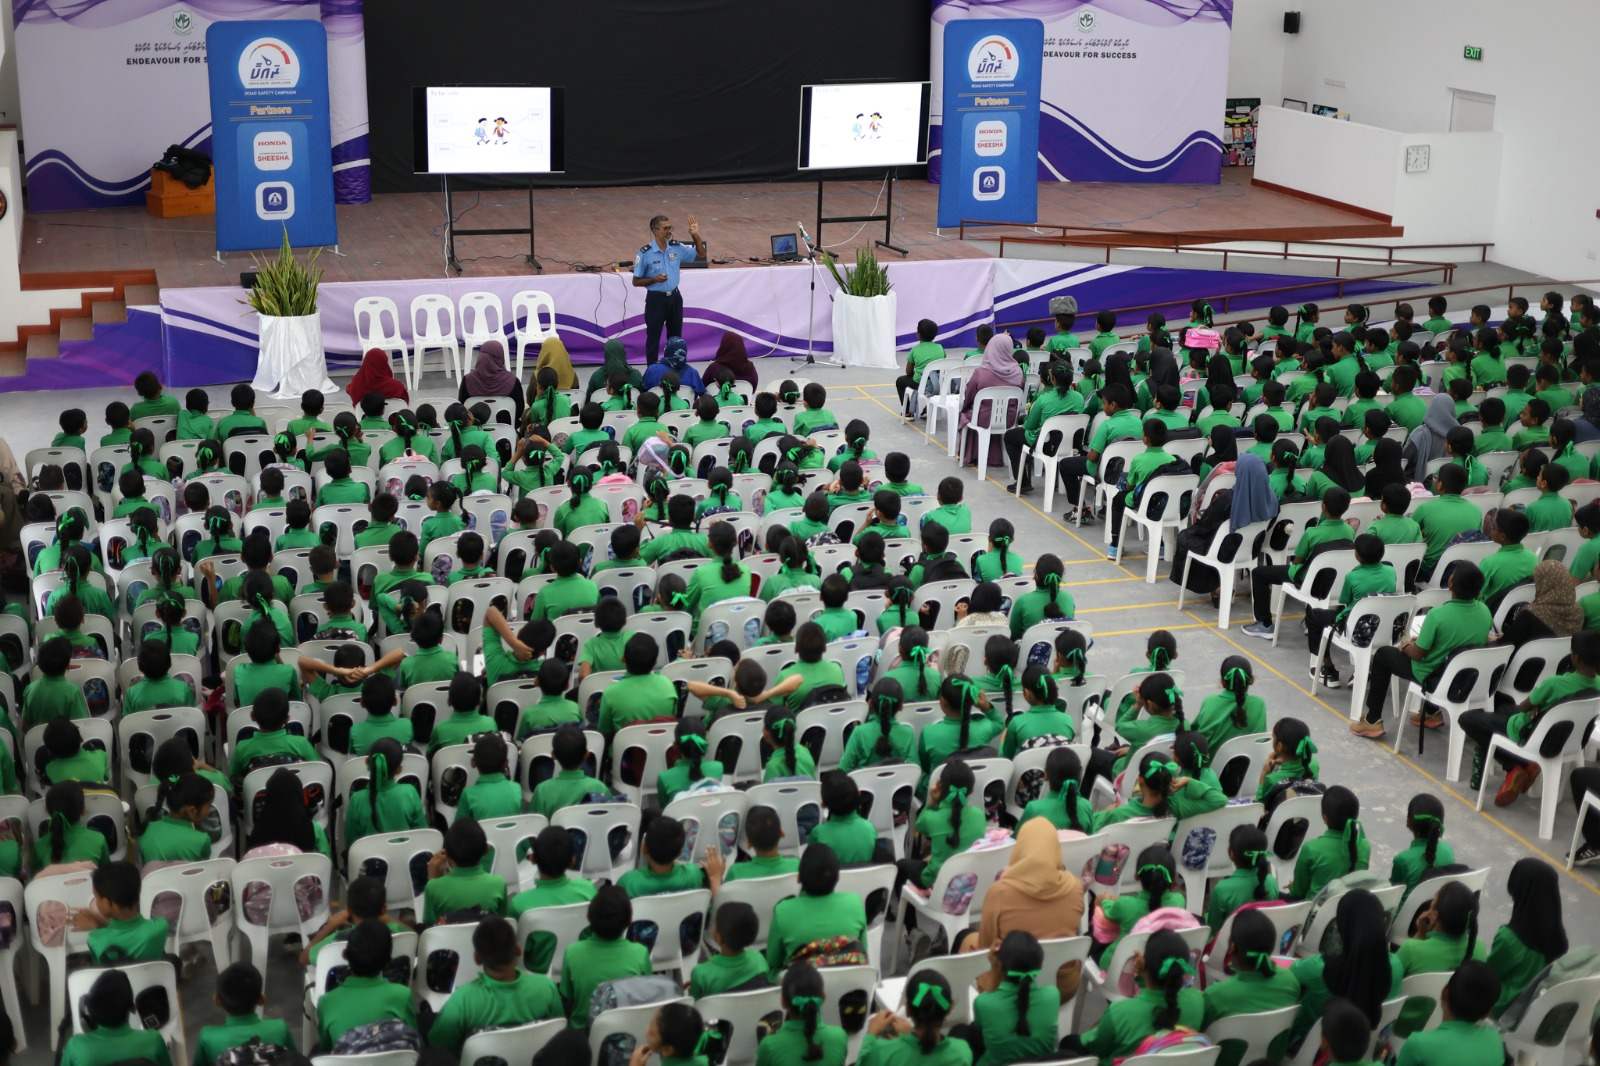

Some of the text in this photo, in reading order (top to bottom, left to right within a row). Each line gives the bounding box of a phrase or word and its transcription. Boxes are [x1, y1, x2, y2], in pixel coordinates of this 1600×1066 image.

[1044, 50, 1081, 58] DEAVOUR
[1083, 51, 1099, 59] FOR
[1466, 48, 1480, 59] EXIT
[126, 57, 180, 65] ENDEAVOUR
